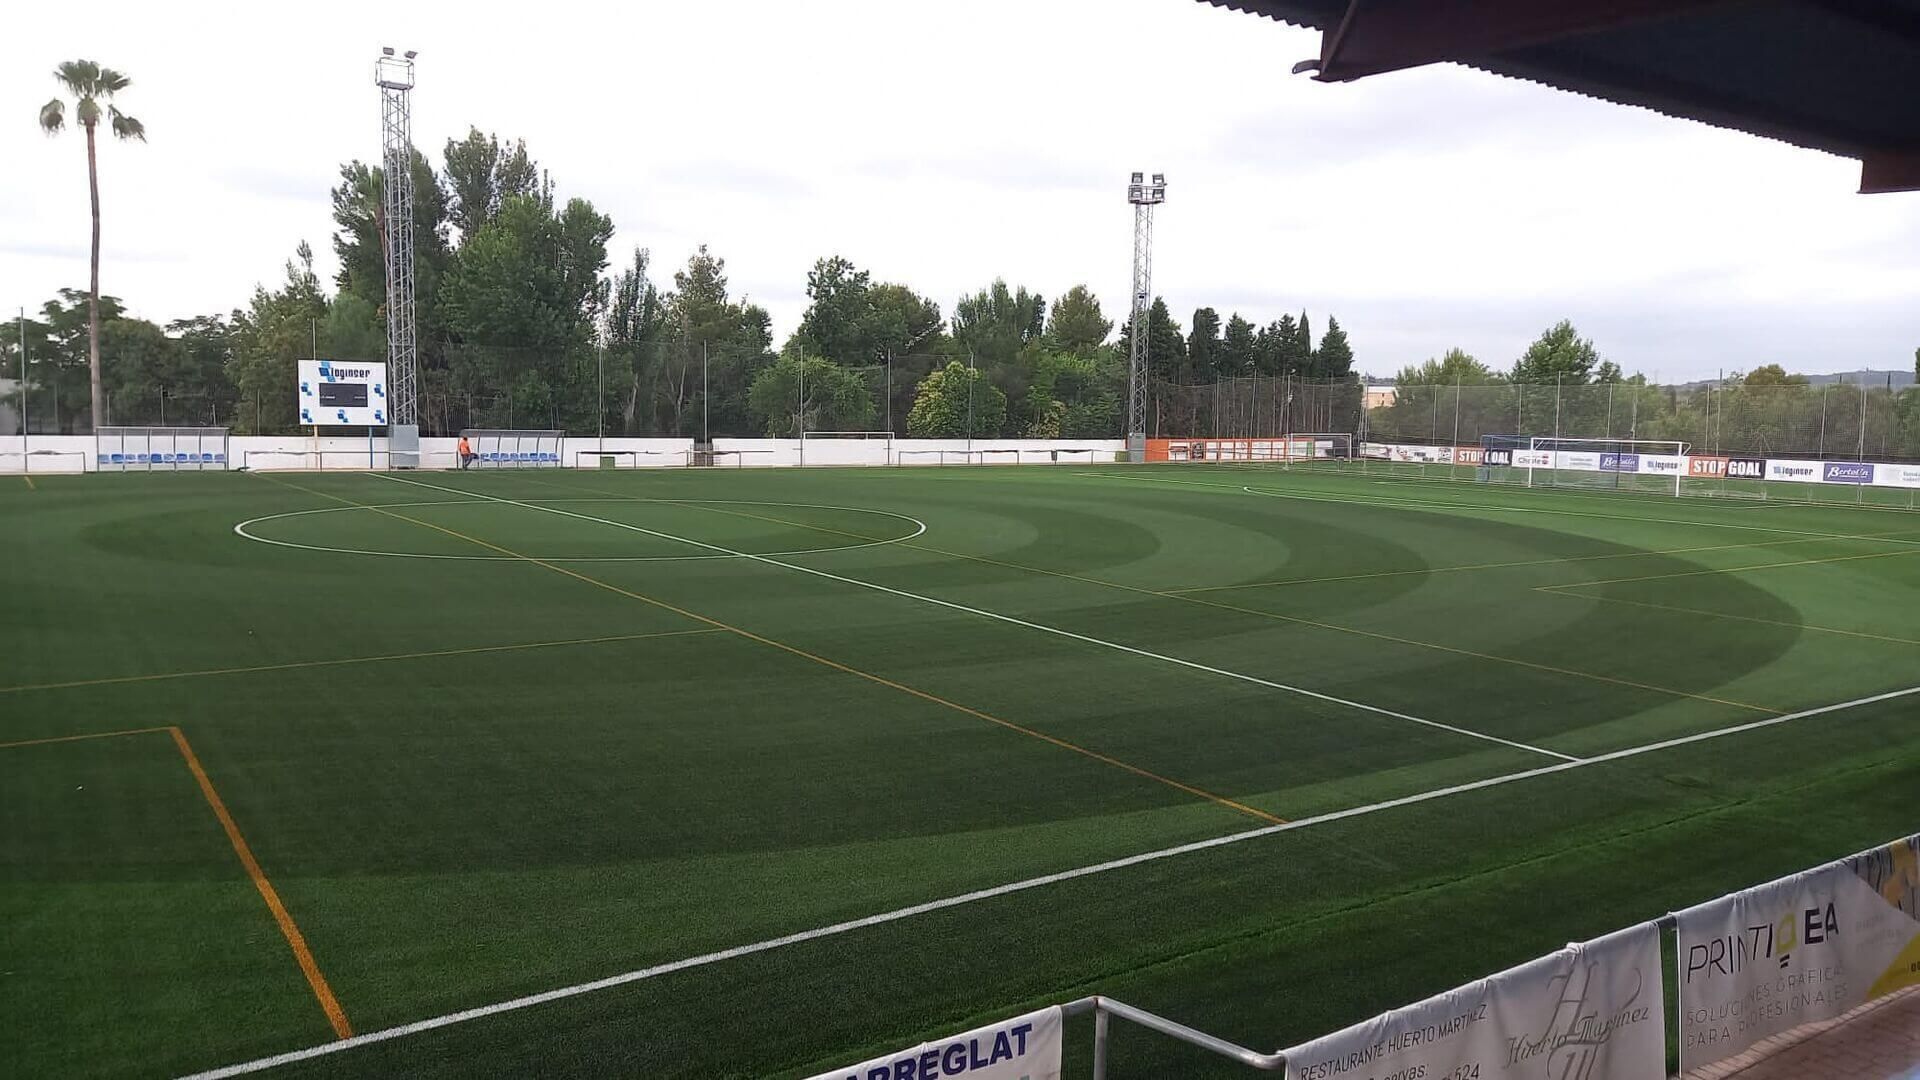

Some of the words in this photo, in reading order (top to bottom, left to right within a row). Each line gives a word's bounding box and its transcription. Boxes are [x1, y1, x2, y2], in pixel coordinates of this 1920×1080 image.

[330, 367, 371, 380] loginser
[1693, 459, 1726, 474] STOP
[1728, 461, 1761, 476] GOAL
[1300, 1042, 1385, 1080] RESTAURANTE
[1388, 1026, 1435, 1052] HUERTO
